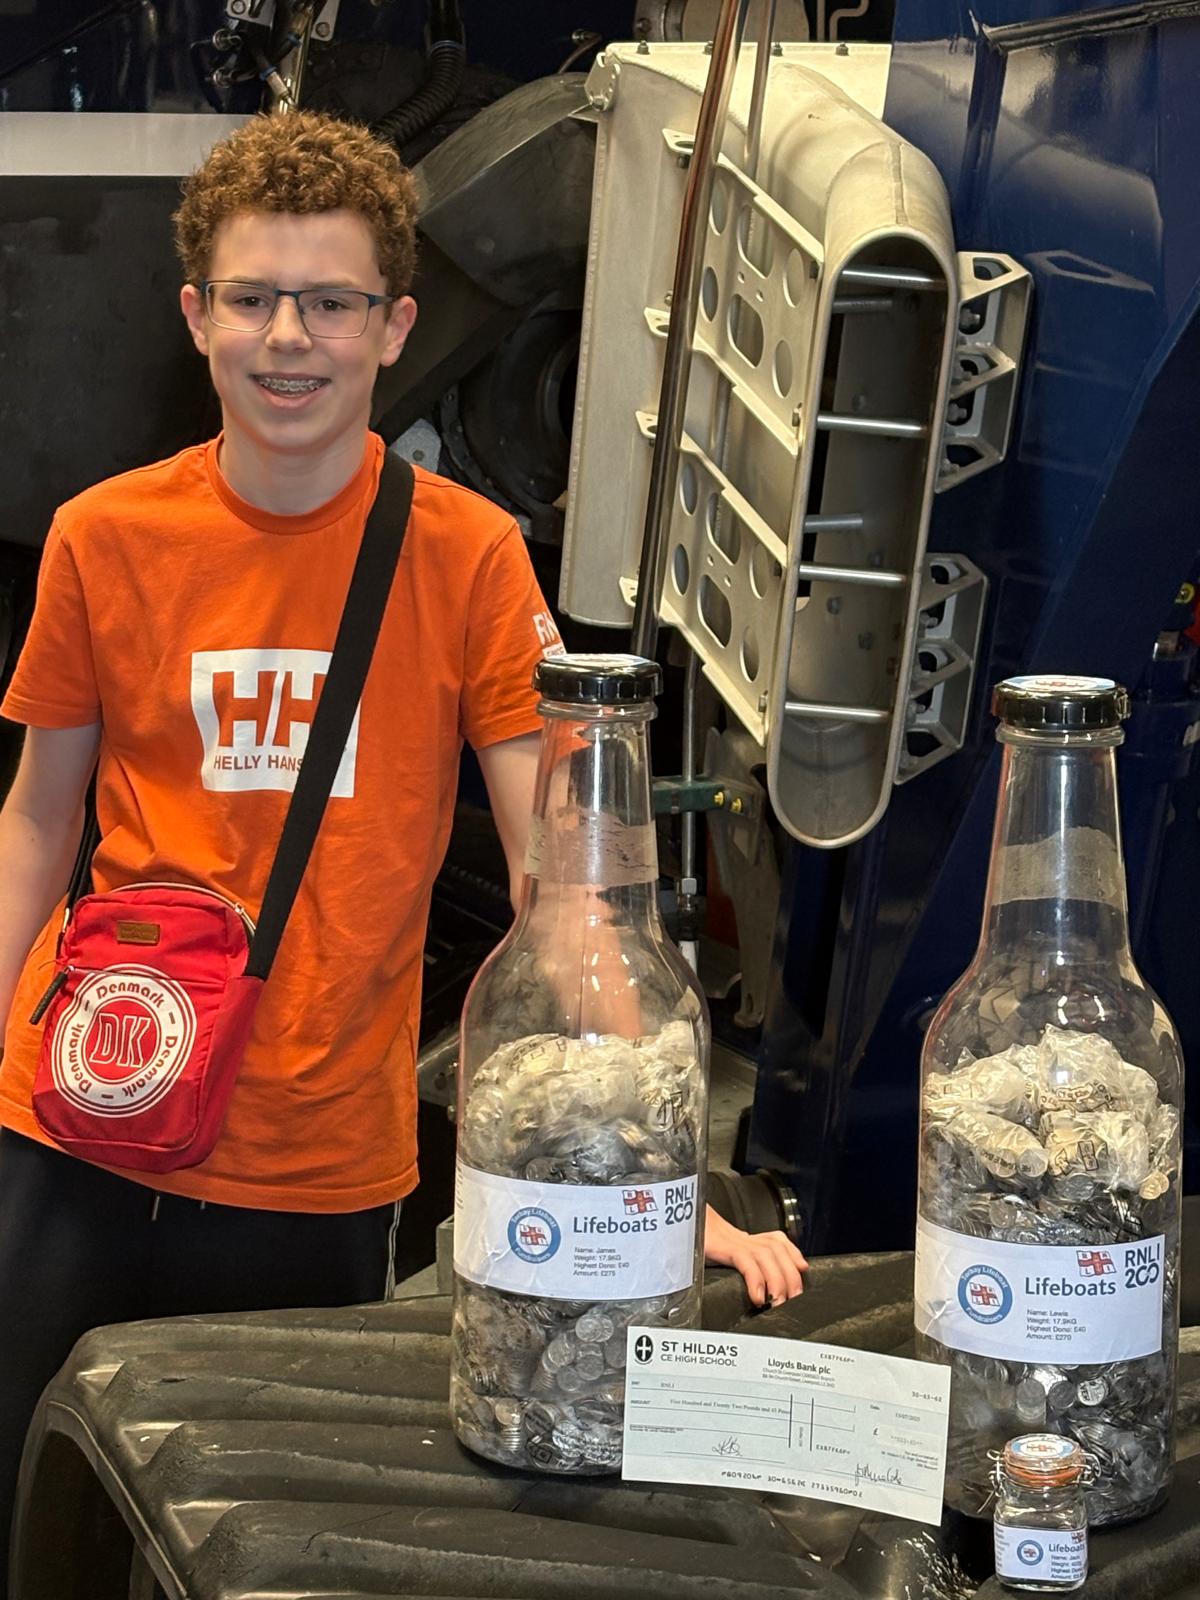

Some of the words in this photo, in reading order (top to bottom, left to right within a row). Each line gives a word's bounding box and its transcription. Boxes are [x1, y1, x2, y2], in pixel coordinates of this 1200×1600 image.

[213, 755, 261, 770] HELLY
[267, 755, 304, 772] HANS
[96, 982, 165, 1008] Denmark
[89, 1012, 152, 1068] DK
[68, 1023, 93, 1094] Denmark
[121, 1035, 179, 1098] Denmark
[665, 1182, 694, 1206] RNLI
[573, 1216, 658, 1234] Lifeboats
[1125, 1243, 1160, 1268] RNLI
[1025, 1276, 1116, 1296] Lifeboats
[661, 1341, 679, 1352] ST
[683, 1342, 738, 1357] HILDA'S
[660, 1354, 673, 1362] CE
[674, 1355, 697, 1364] HIGH
[699, 1356, 737, 1367] SCHOOL
[767, 1358, 795, 1370] Lloyds
[796, 1362, 817, 1372] Bank
[818, 1365, 831, 1375] plc
